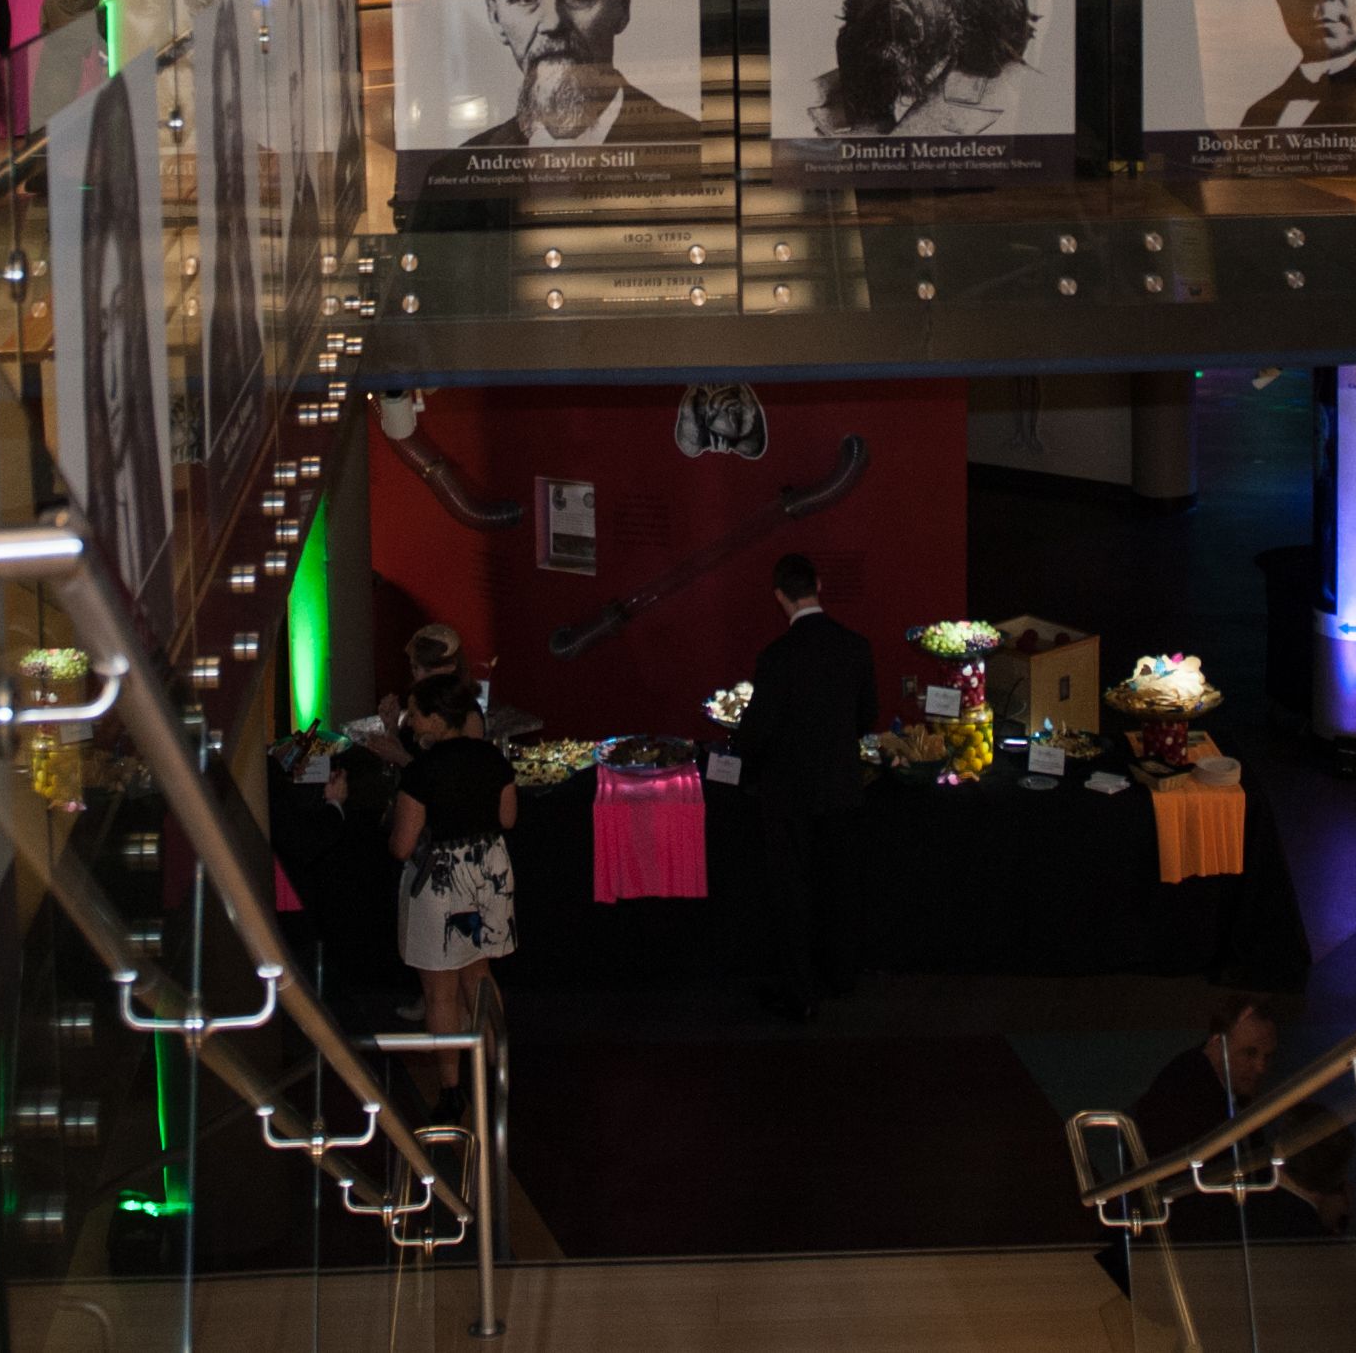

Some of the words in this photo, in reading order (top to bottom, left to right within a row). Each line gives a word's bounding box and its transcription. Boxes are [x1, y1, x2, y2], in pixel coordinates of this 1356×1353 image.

[841, 143, 906, 160] Dimitri
[911, 141, 1007, 158] Mendeleev
[1197, 133, 1261, 152] Booker
[1264, 133, 1282, 150] T.
[466, 154, 537, 171] Andrew
[543, 153, 596, 173] Taylor
[599, 152, 636, 167] Still
